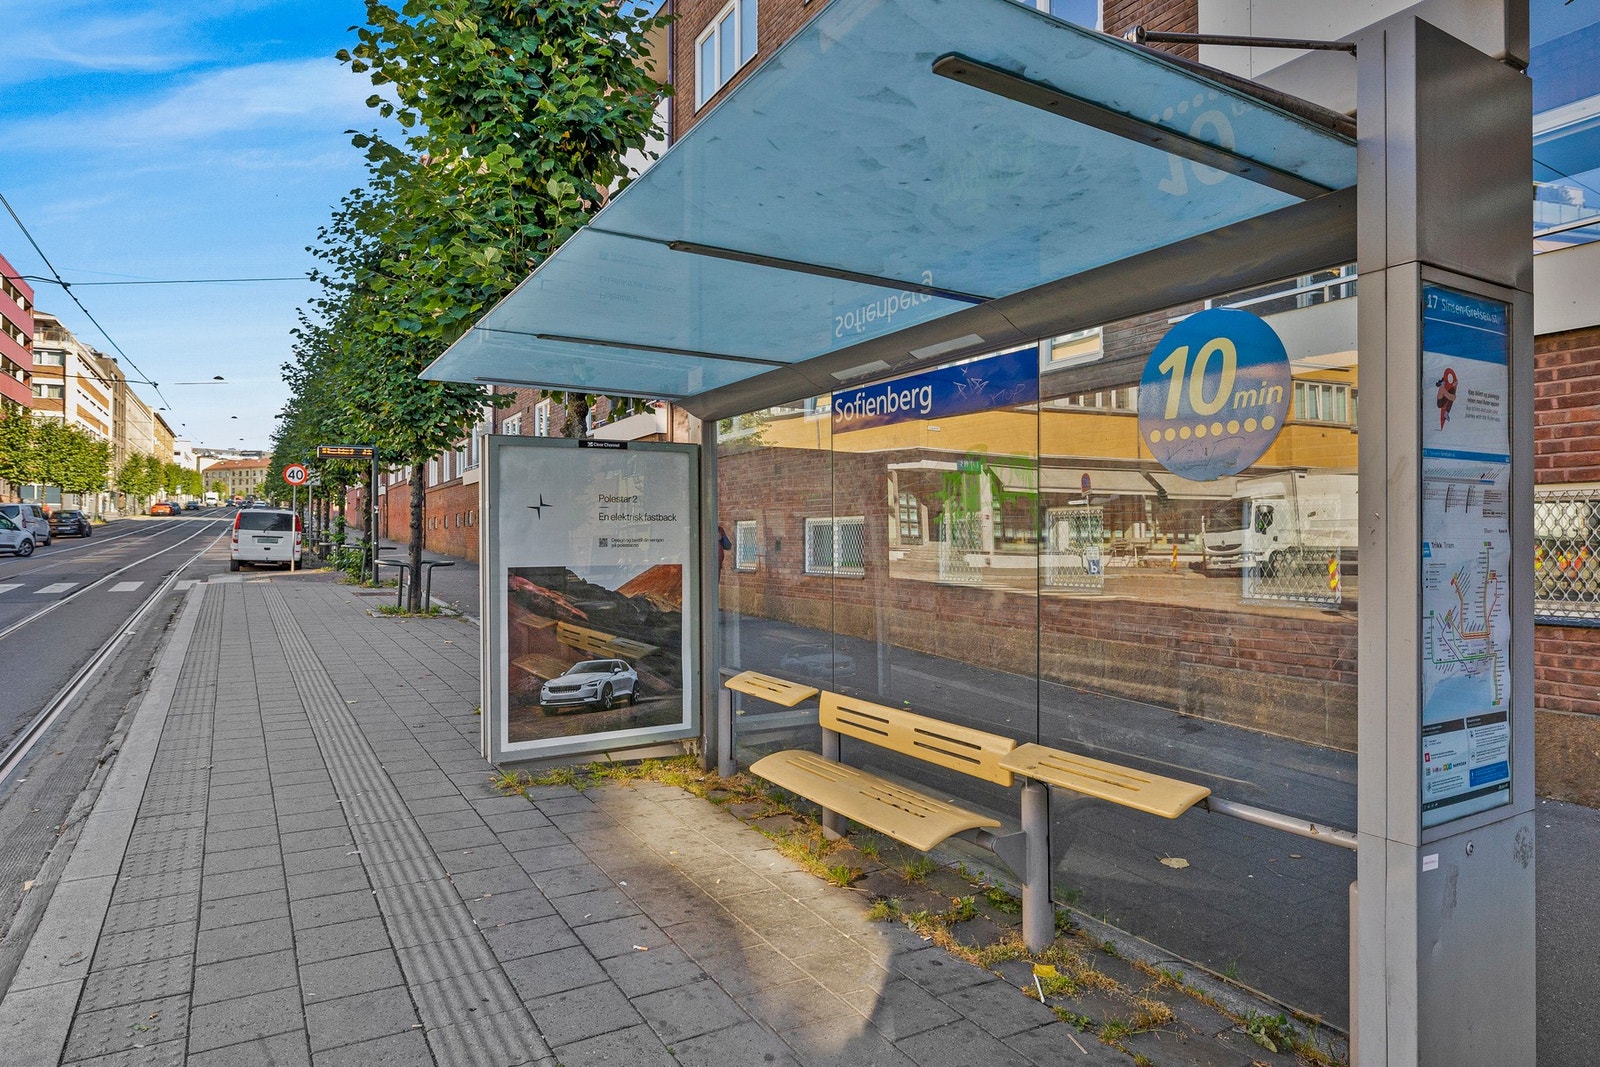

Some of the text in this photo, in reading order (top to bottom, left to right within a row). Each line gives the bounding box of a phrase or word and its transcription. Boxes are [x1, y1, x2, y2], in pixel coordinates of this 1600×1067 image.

[1427, 294, 1438, 309] 17
[1158, 337, 1284, 420] 10 min
[835, 385, 932, 423] Sofienberg
[287, 469, 304, 480] 40
[598, 494, 638, 503] Polestar 2
[598, 512, 677, 521] En elektrisk fastback
